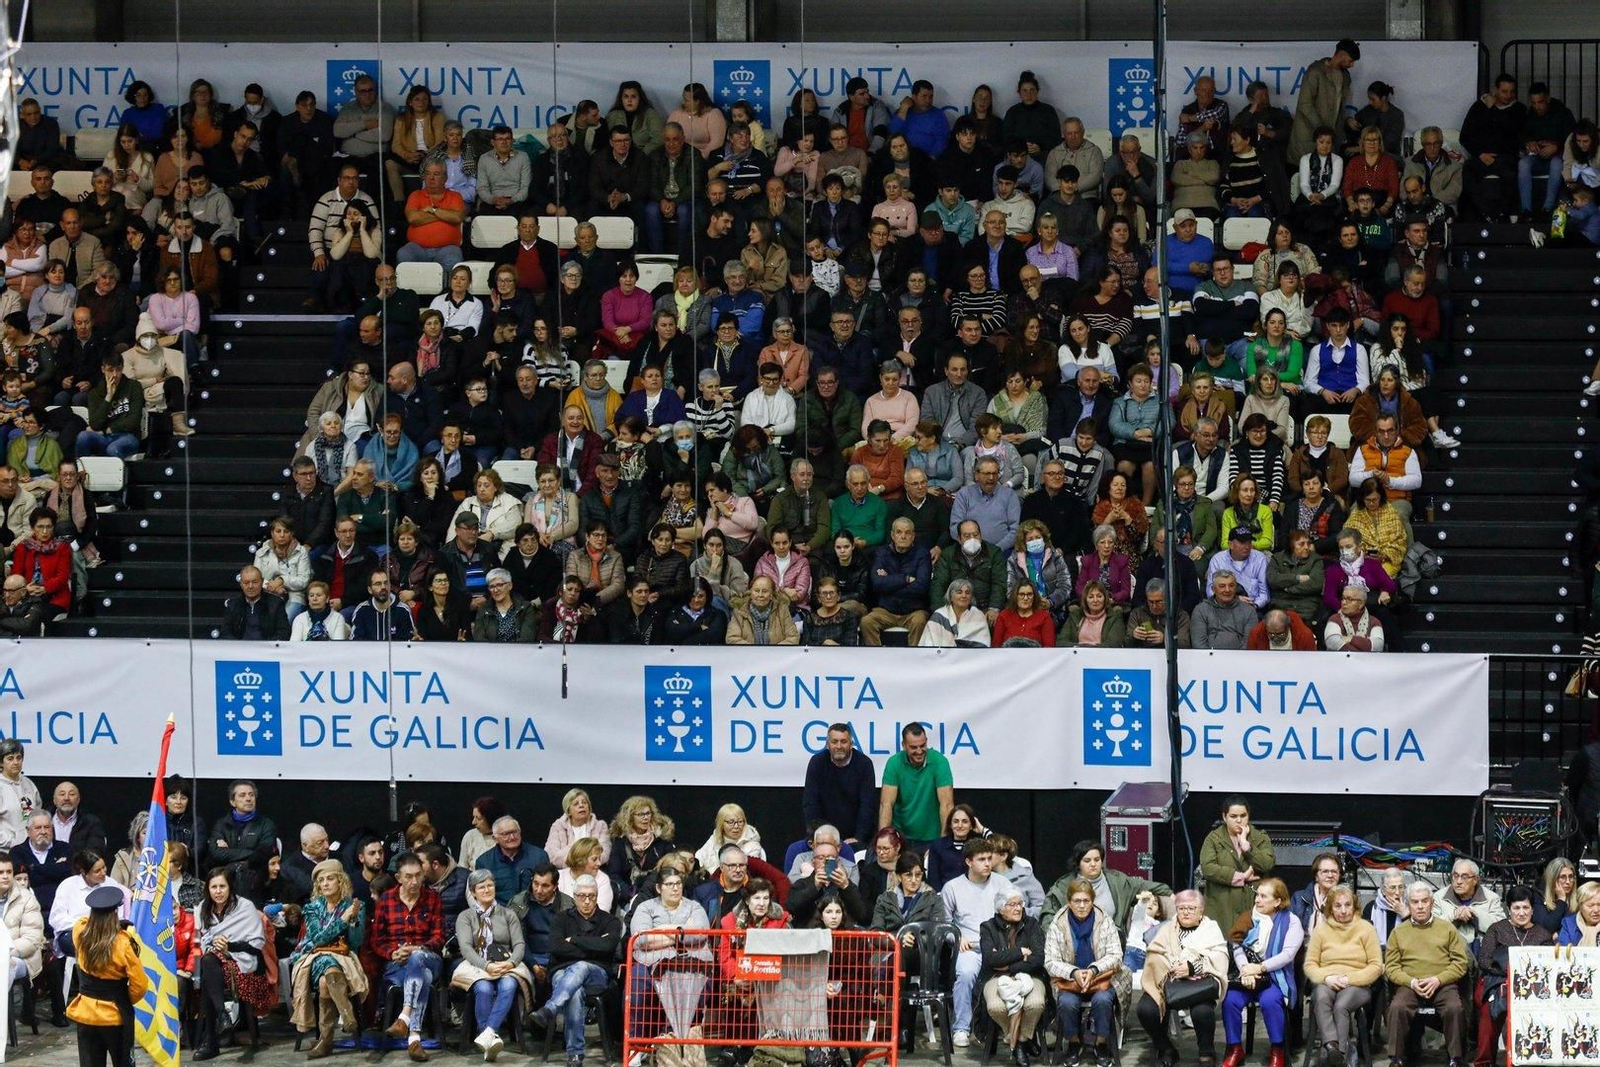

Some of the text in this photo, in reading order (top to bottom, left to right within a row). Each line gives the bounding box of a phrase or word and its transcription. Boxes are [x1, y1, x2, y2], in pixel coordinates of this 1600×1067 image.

[19, 66, 135, 96] XUNTA
[400, 66, 525, 95] XUNTA
[788, 66, 913, 97] XUNTA
[1185, 66, 1305, 94] XUNTA
[300, 669, 451, 706] XUNTA
[731, 674, 884, 711] XUNTA
[1177, 679, 1327, 717] XUNTA
[0, 711, 119, 747] LICIA
[299, 713, 545, 752] DE GALICIA
[729, 718, 980, 757] DE GLIIA
[1179, 723, 1426, 763] DE GALICIA
